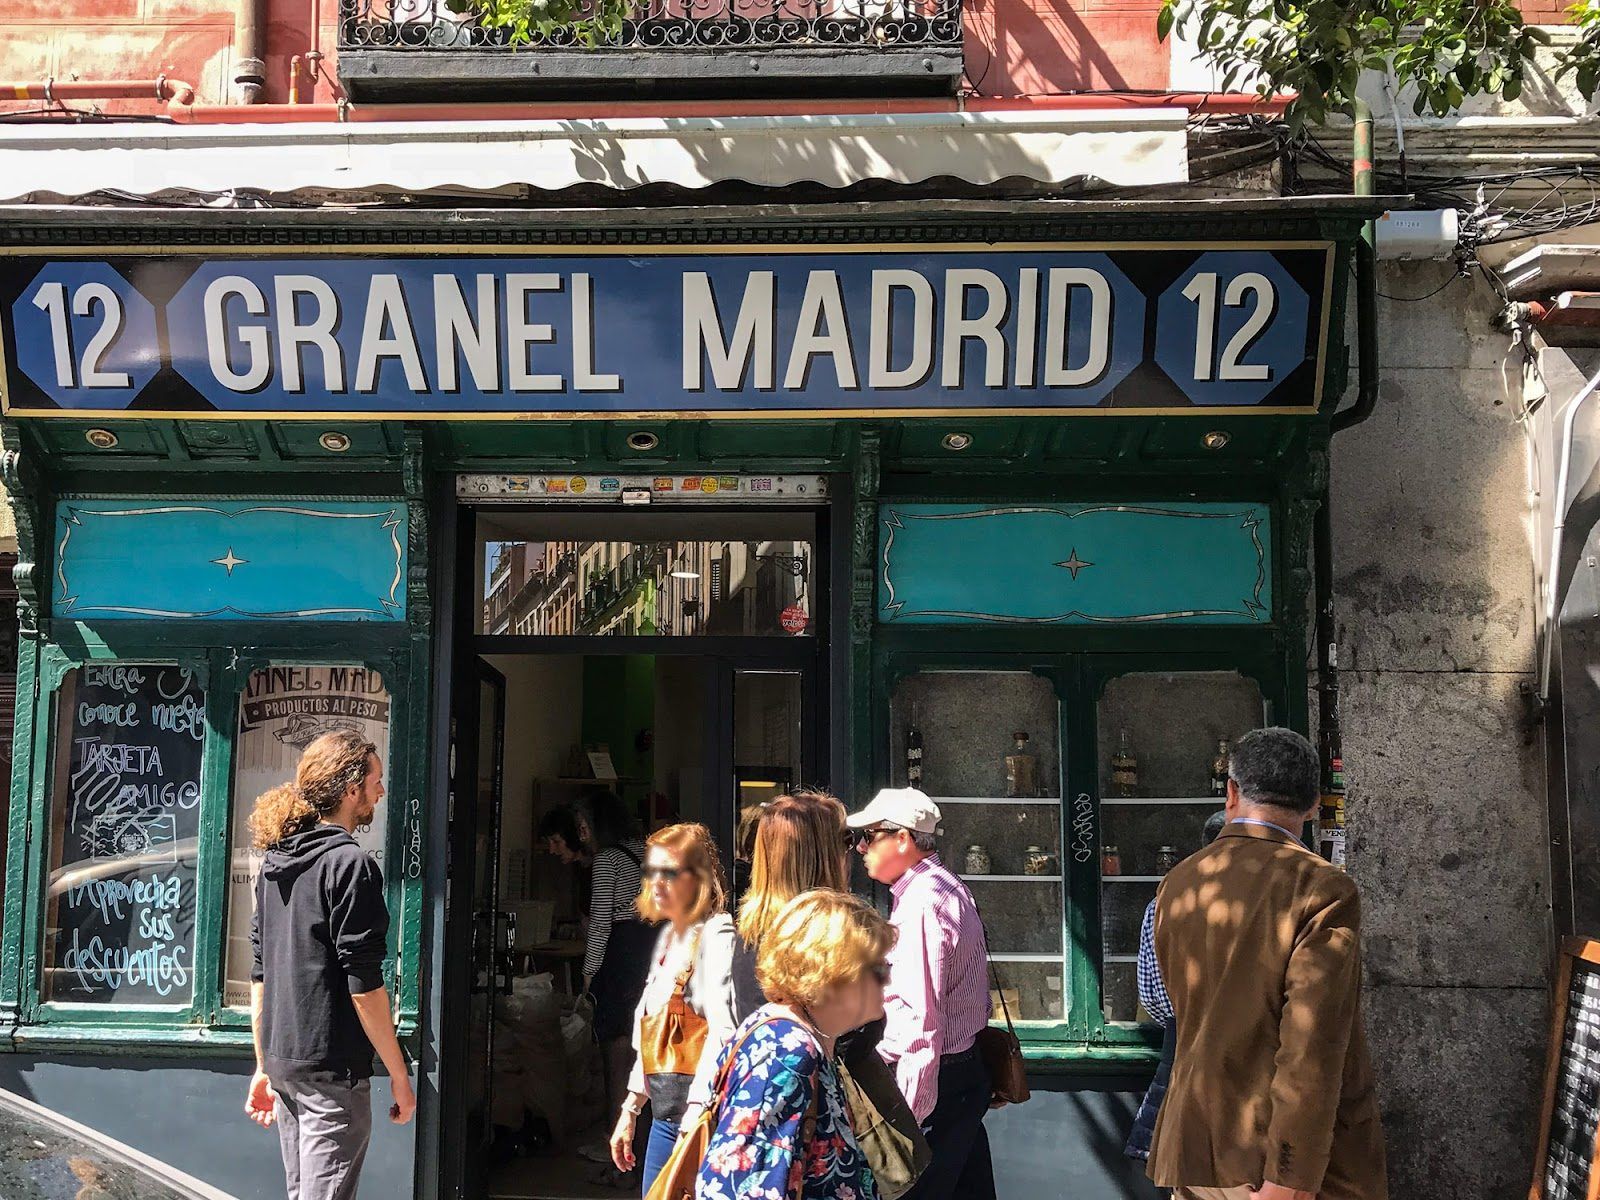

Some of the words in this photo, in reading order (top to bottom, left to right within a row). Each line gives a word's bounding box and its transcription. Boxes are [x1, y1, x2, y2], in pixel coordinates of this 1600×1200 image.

[31, 281, 130, 388] 12
[202, 272, 621, 392] GRANEL
[682, 267, 1112, 390] MADRID
[1181, 271, 1274, 382] 12
[328, 667, 387, 696] MAD
[265, 698, 330, 717] PRODUCTOS
[332, 699, 346, 713] AL
[350, 700, 378, 717] PESO
[75, 736, 163, 776] TARJETA
